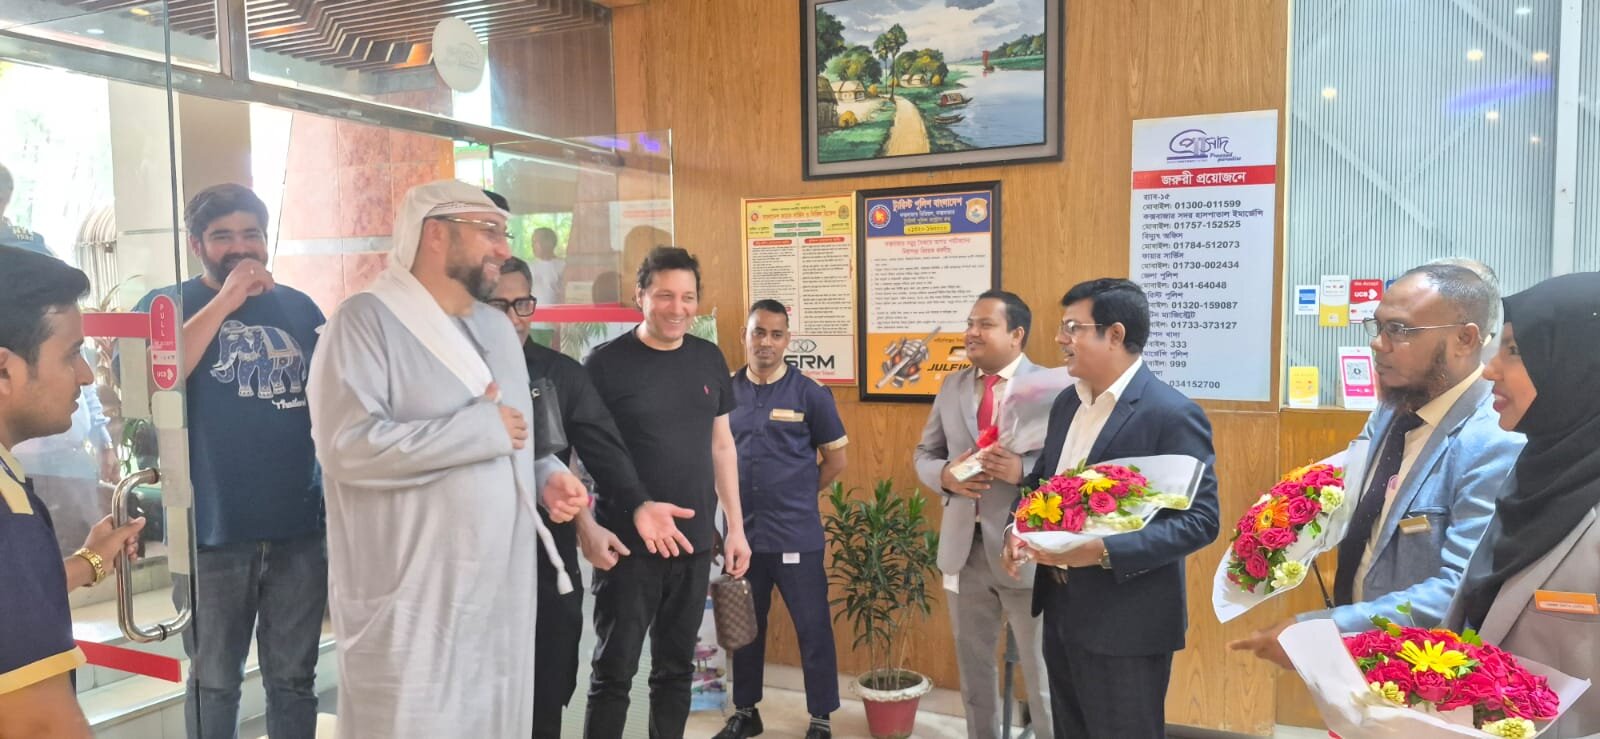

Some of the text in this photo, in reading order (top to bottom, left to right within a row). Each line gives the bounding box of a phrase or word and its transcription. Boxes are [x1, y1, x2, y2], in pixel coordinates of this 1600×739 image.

[1161, 170, 1247, 185] জরুরী প্রয়োজনে
[1174, 200, 1242, 210] 01300-011599
[1174, 220, 1241, 229] 01757-152525
[1173, 240, 1240, 250] 01784-512073
[1172, 260, 1240, 269] 01730-002434
[1171, 281, 1227, 289] 0341-64048
[1171, 301, 1238, 310] 01320-159087
[1170, 321, 1238, 330] 01733-373127
[1170, 340, 1188, 349] 333
[784, 354, 835, 369] SRM
[1169, 360, 1187, 368] 999
[1169, 380, 1220, 389] 034152700
